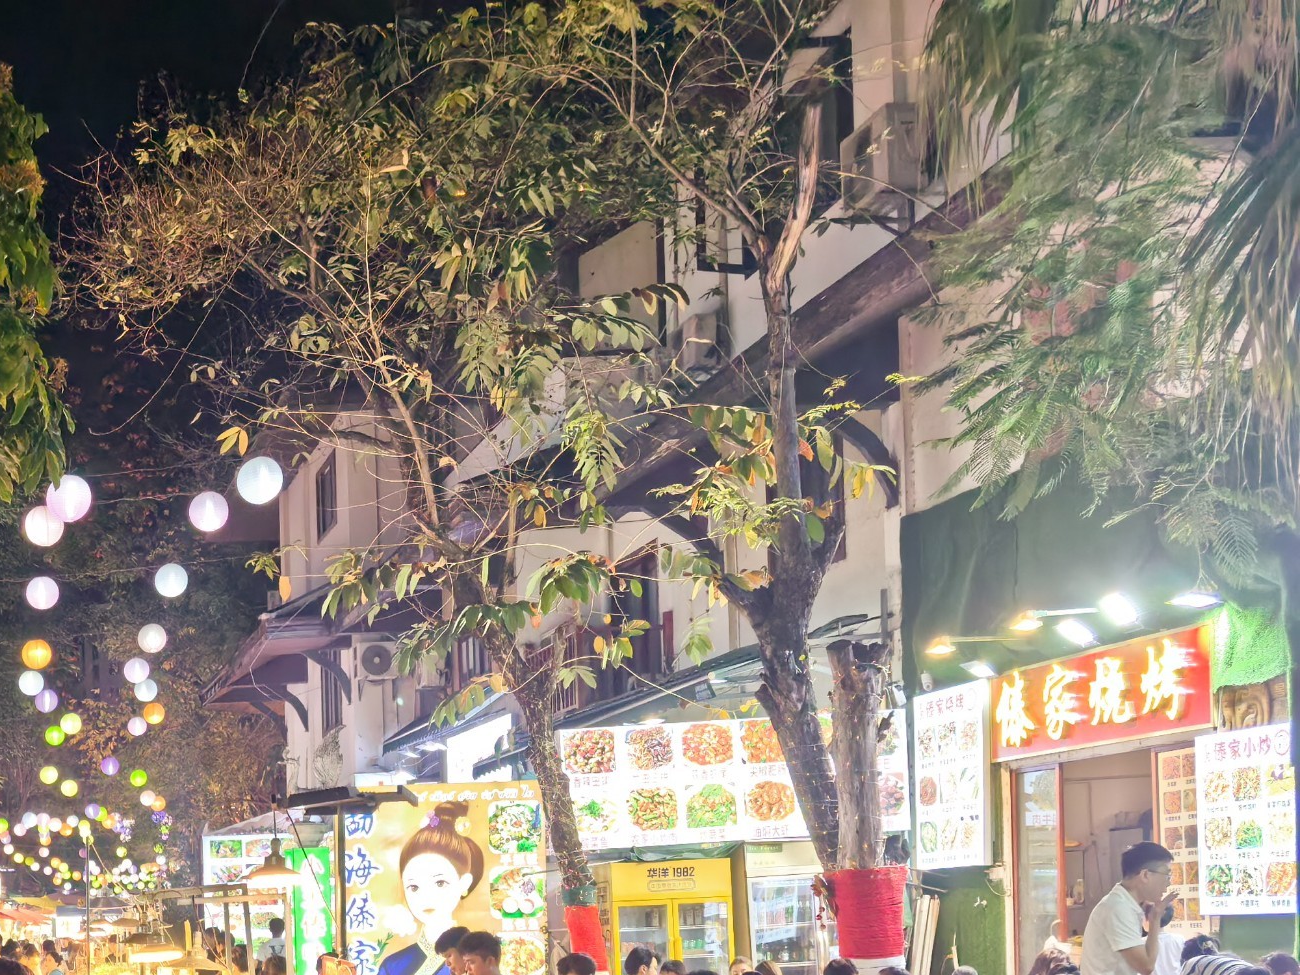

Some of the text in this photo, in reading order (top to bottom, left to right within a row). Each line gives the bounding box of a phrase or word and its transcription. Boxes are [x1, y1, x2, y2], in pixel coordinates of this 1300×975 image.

[996, 638, 1188, 748] 傣家烧烤
[1214, 735, 1271, 761] 傣家小炒
[647, 866, 695, 879] 华洋 1982
